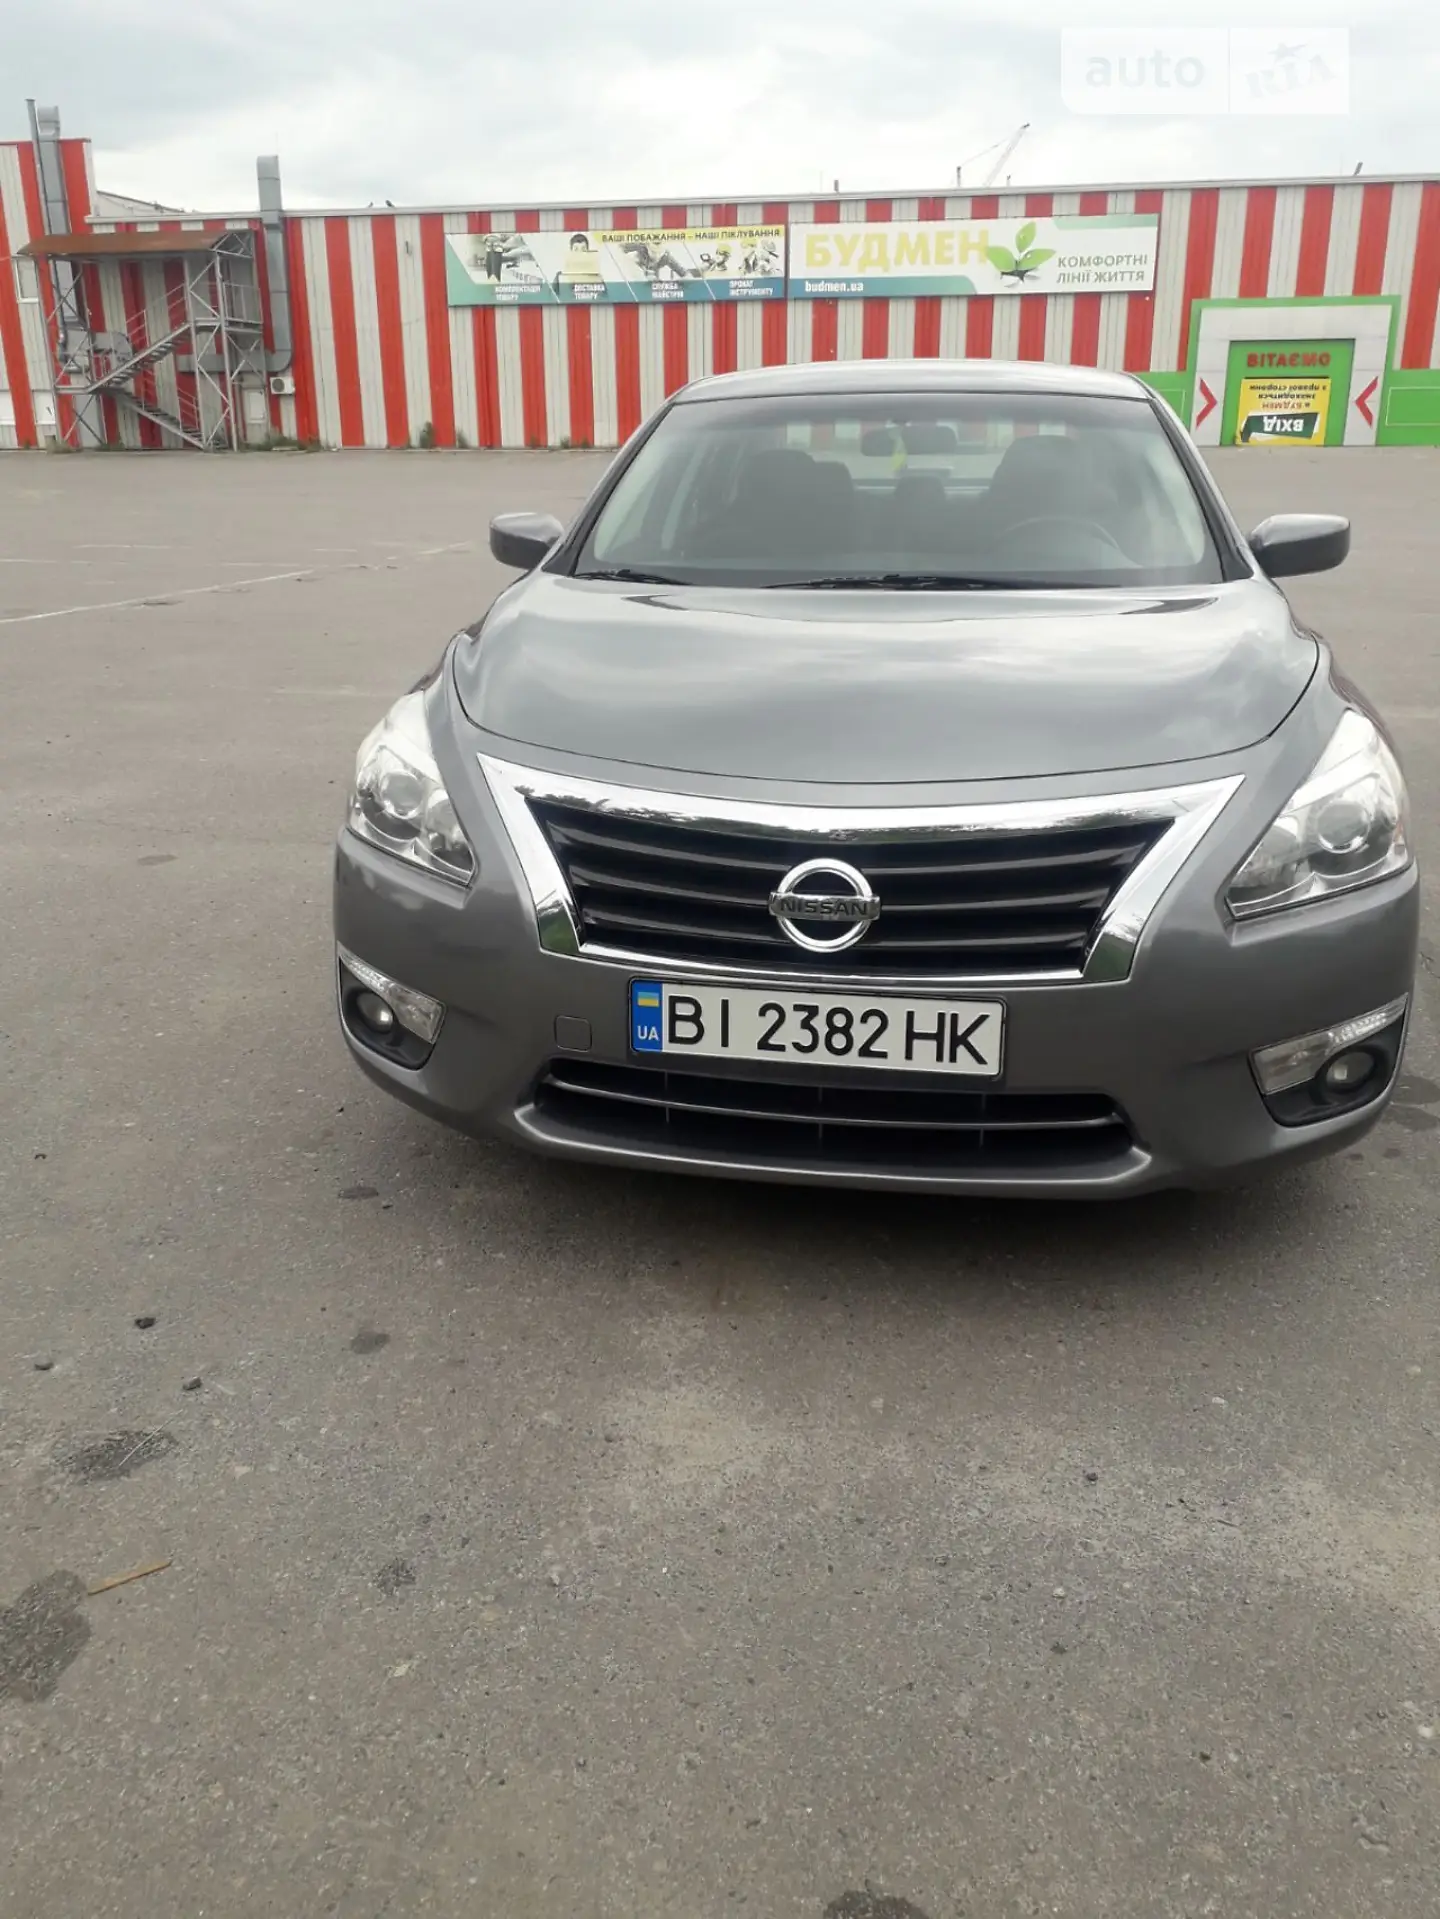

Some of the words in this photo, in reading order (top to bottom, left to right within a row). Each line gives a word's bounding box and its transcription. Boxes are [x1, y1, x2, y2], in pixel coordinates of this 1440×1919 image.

[602, 234, 624, 242] ВАШІ
[627, 233, 686, 242] ПОБАЖАННЯ
[695, 232, 719, 240] НАШІ
[721, 229, 780, 239] ПІКЛУВАННЯ
[805, 229, 989, 273] БУДМЕН
[1058, 254, 1148, 268] КОМФОРТНІ
[1056, 270, 1091, 284] ЛІНІЇ
[1094, 270, 1145, 283] ЖИТТЯ
[805, 280, 864, 292] budmen.ua
[1247, 352, 1331, 368] ВІТАЄМО
[1263, 416, 1304, 432] ВХІД
[780, 900, 870, 917] NISSAN
[637, 1025, 659, 1041] UA
[667, 994, 730, 1048] BI
[756, 1002, 889, 1060] 2382
[904, 1009, 991, 1066] HK
